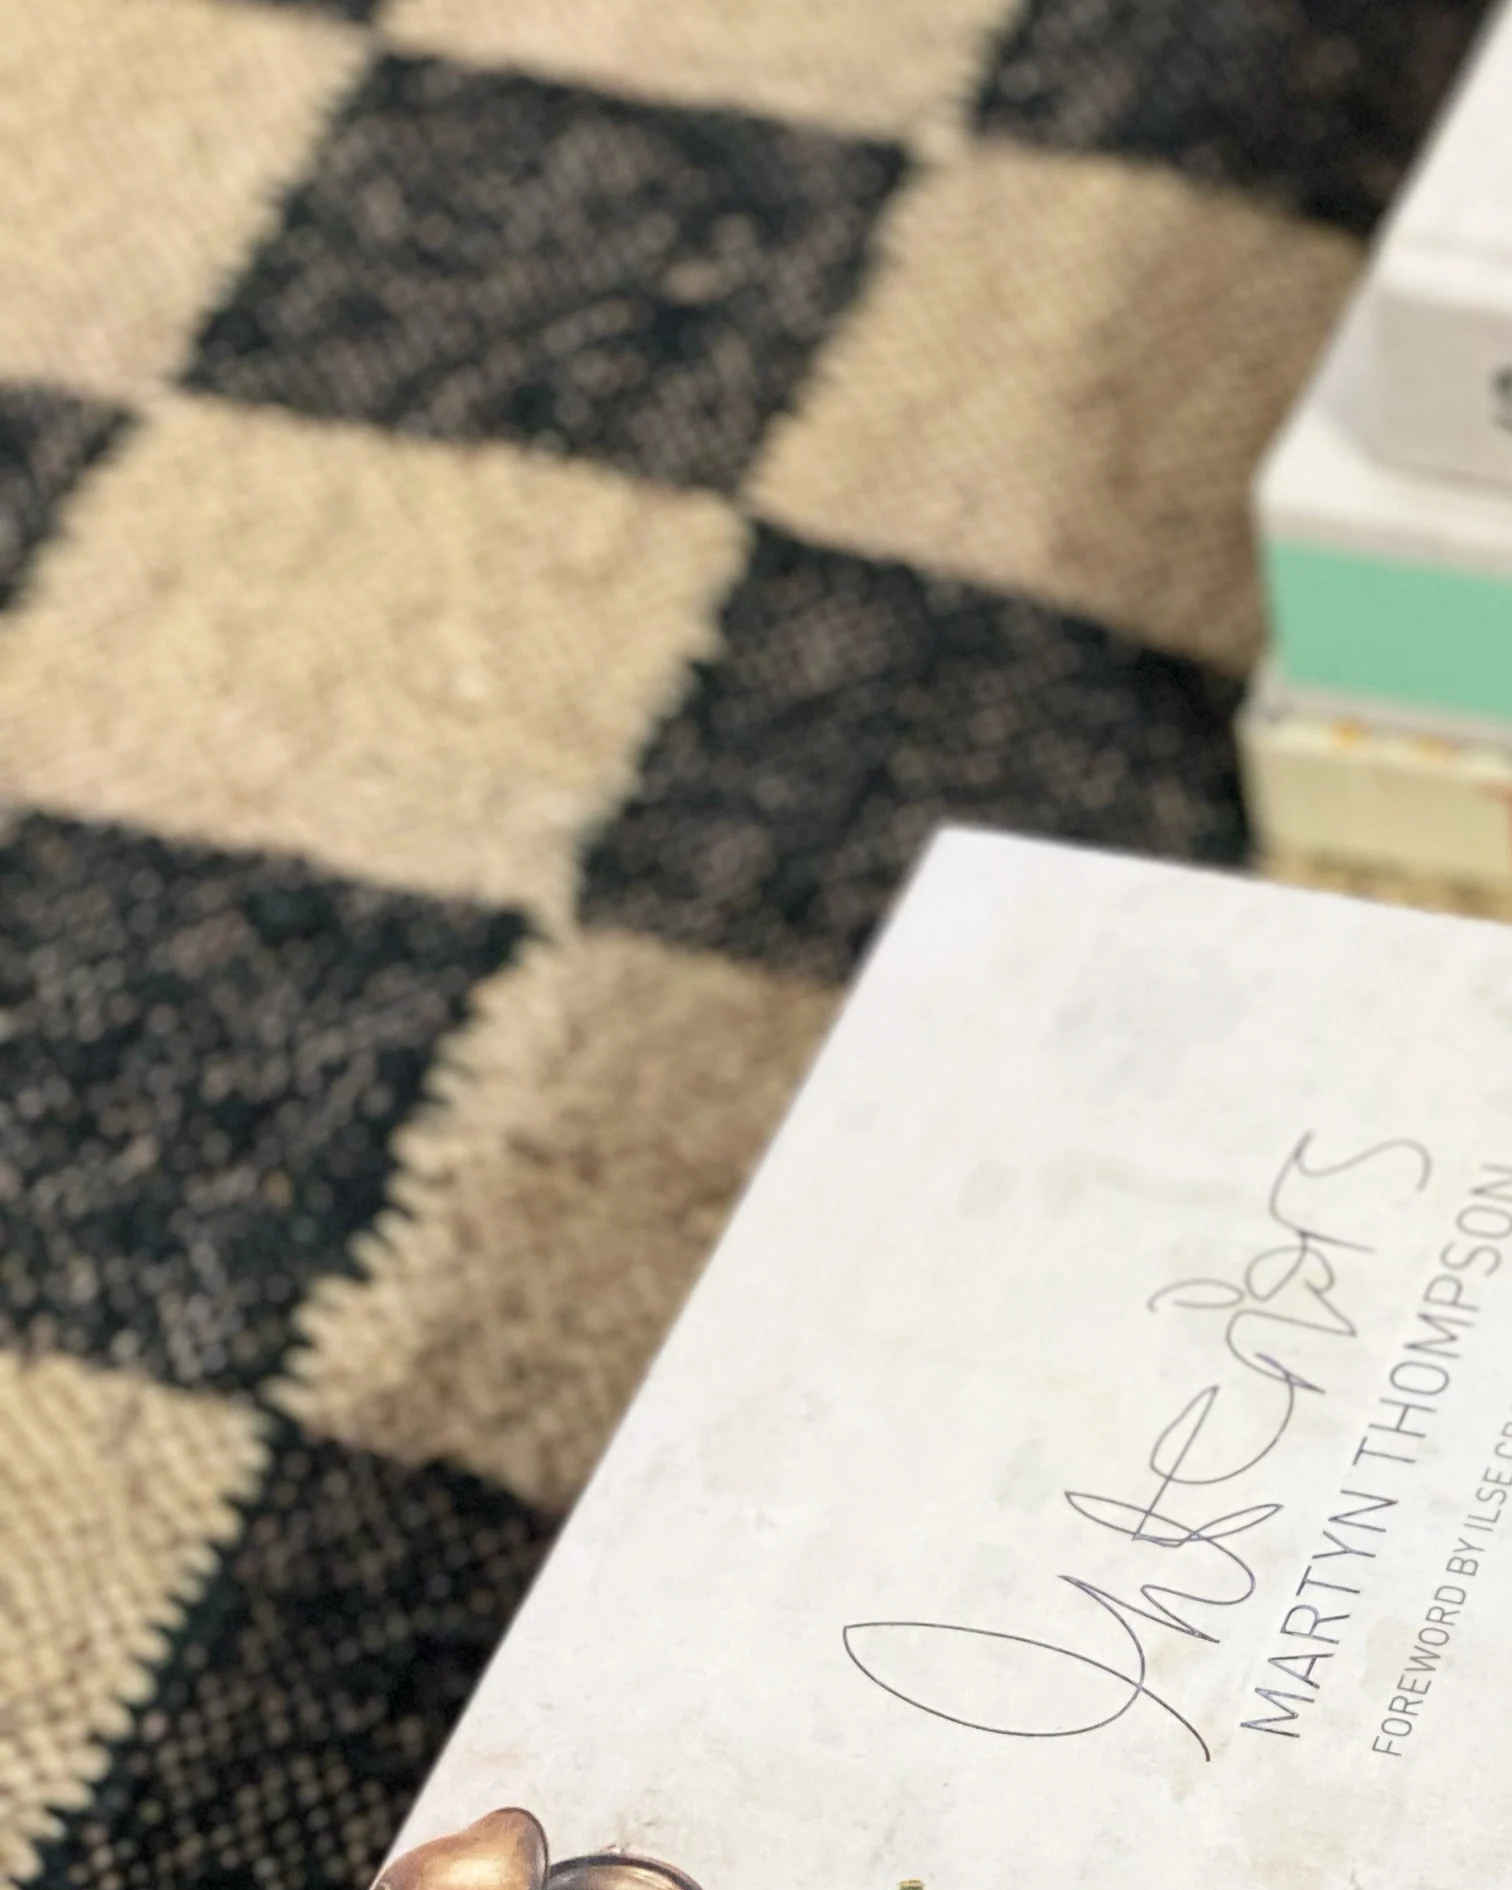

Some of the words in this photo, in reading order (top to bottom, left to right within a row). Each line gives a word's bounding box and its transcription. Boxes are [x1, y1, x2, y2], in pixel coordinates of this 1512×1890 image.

[1239, 1489, 1399, 1739] MARTYN
[1372, 1585, 1467, 1757] FOREWORD
[1446, 1537, 1488, 1577] BY
